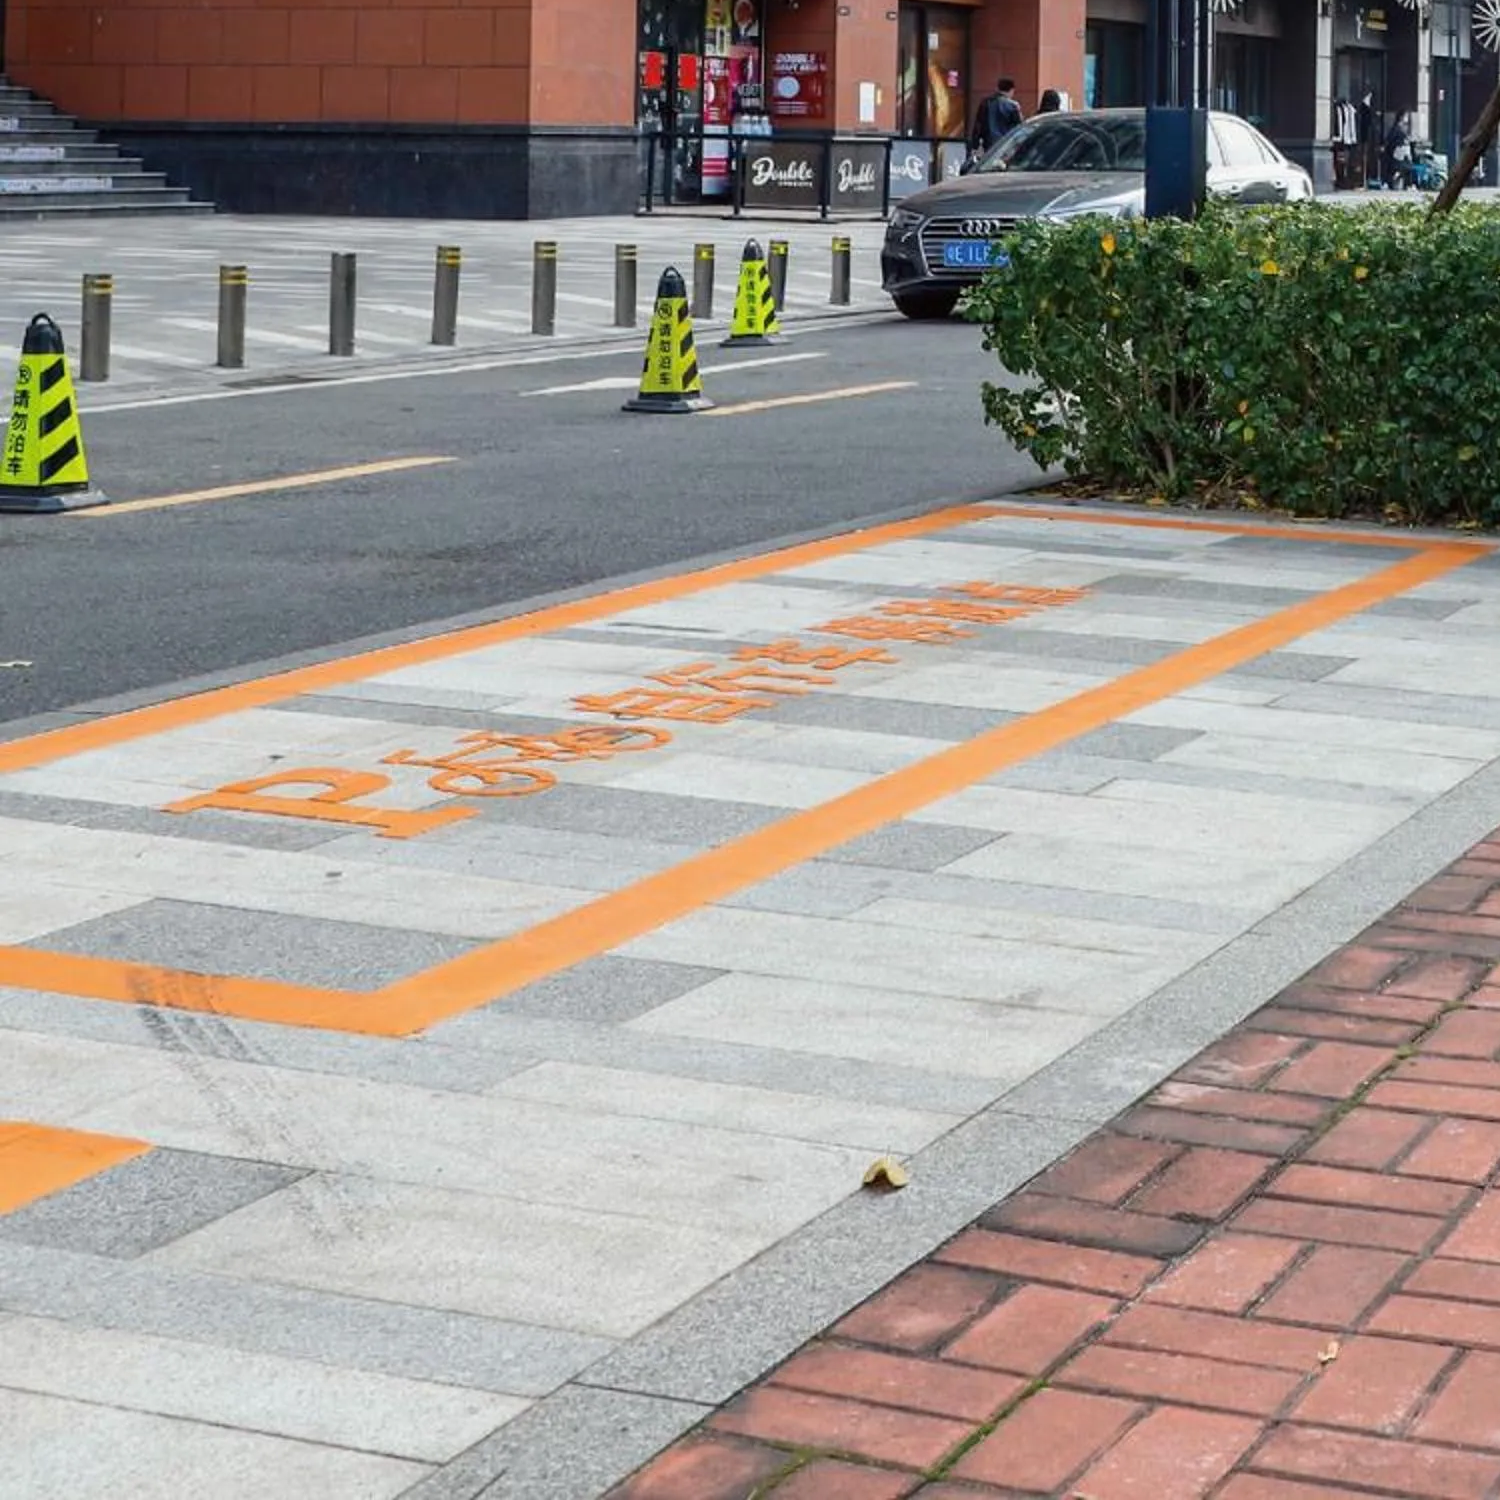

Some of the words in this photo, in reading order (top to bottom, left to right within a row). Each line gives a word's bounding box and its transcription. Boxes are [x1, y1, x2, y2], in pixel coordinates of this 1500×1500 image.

[751, 156, 815, 186] Double
[7, 389, 30, 476] 请勿泊车
[158, 766, 482, 840] P
